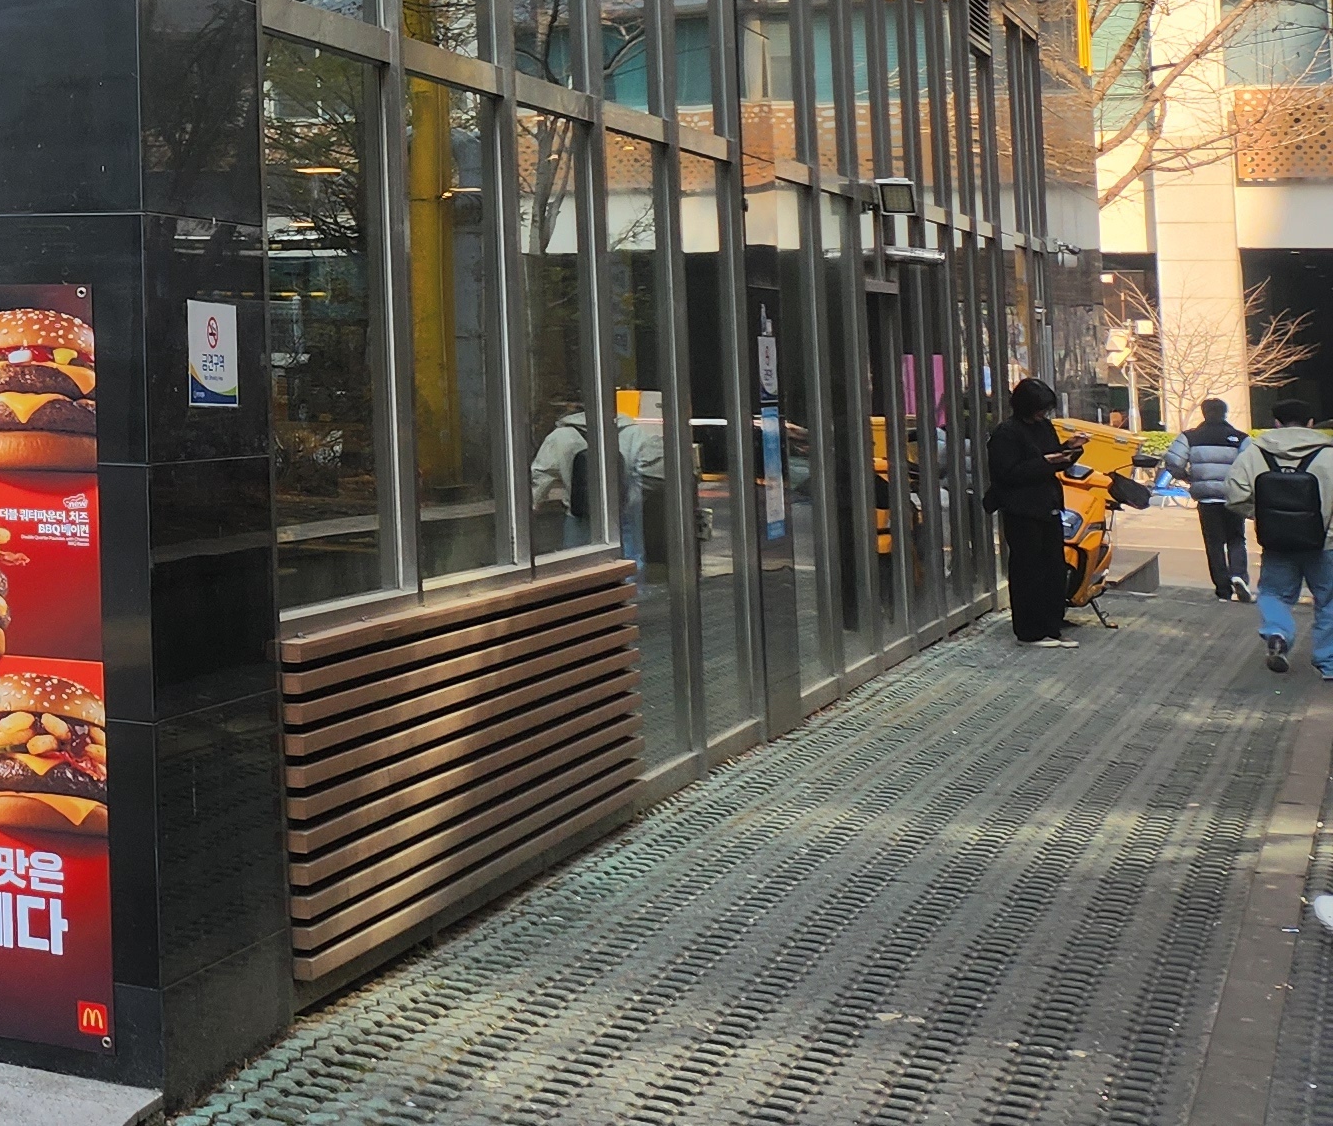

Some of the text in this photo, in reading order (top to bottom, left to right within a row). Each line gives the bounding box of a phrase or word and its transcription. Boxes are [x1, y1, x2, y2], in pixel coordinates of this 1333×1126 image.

[201, 353, 225, 372] 금연구역
[68, 511, 90, 523] 치즈
[38, 523, 90, 537] BBQ 베이컨
